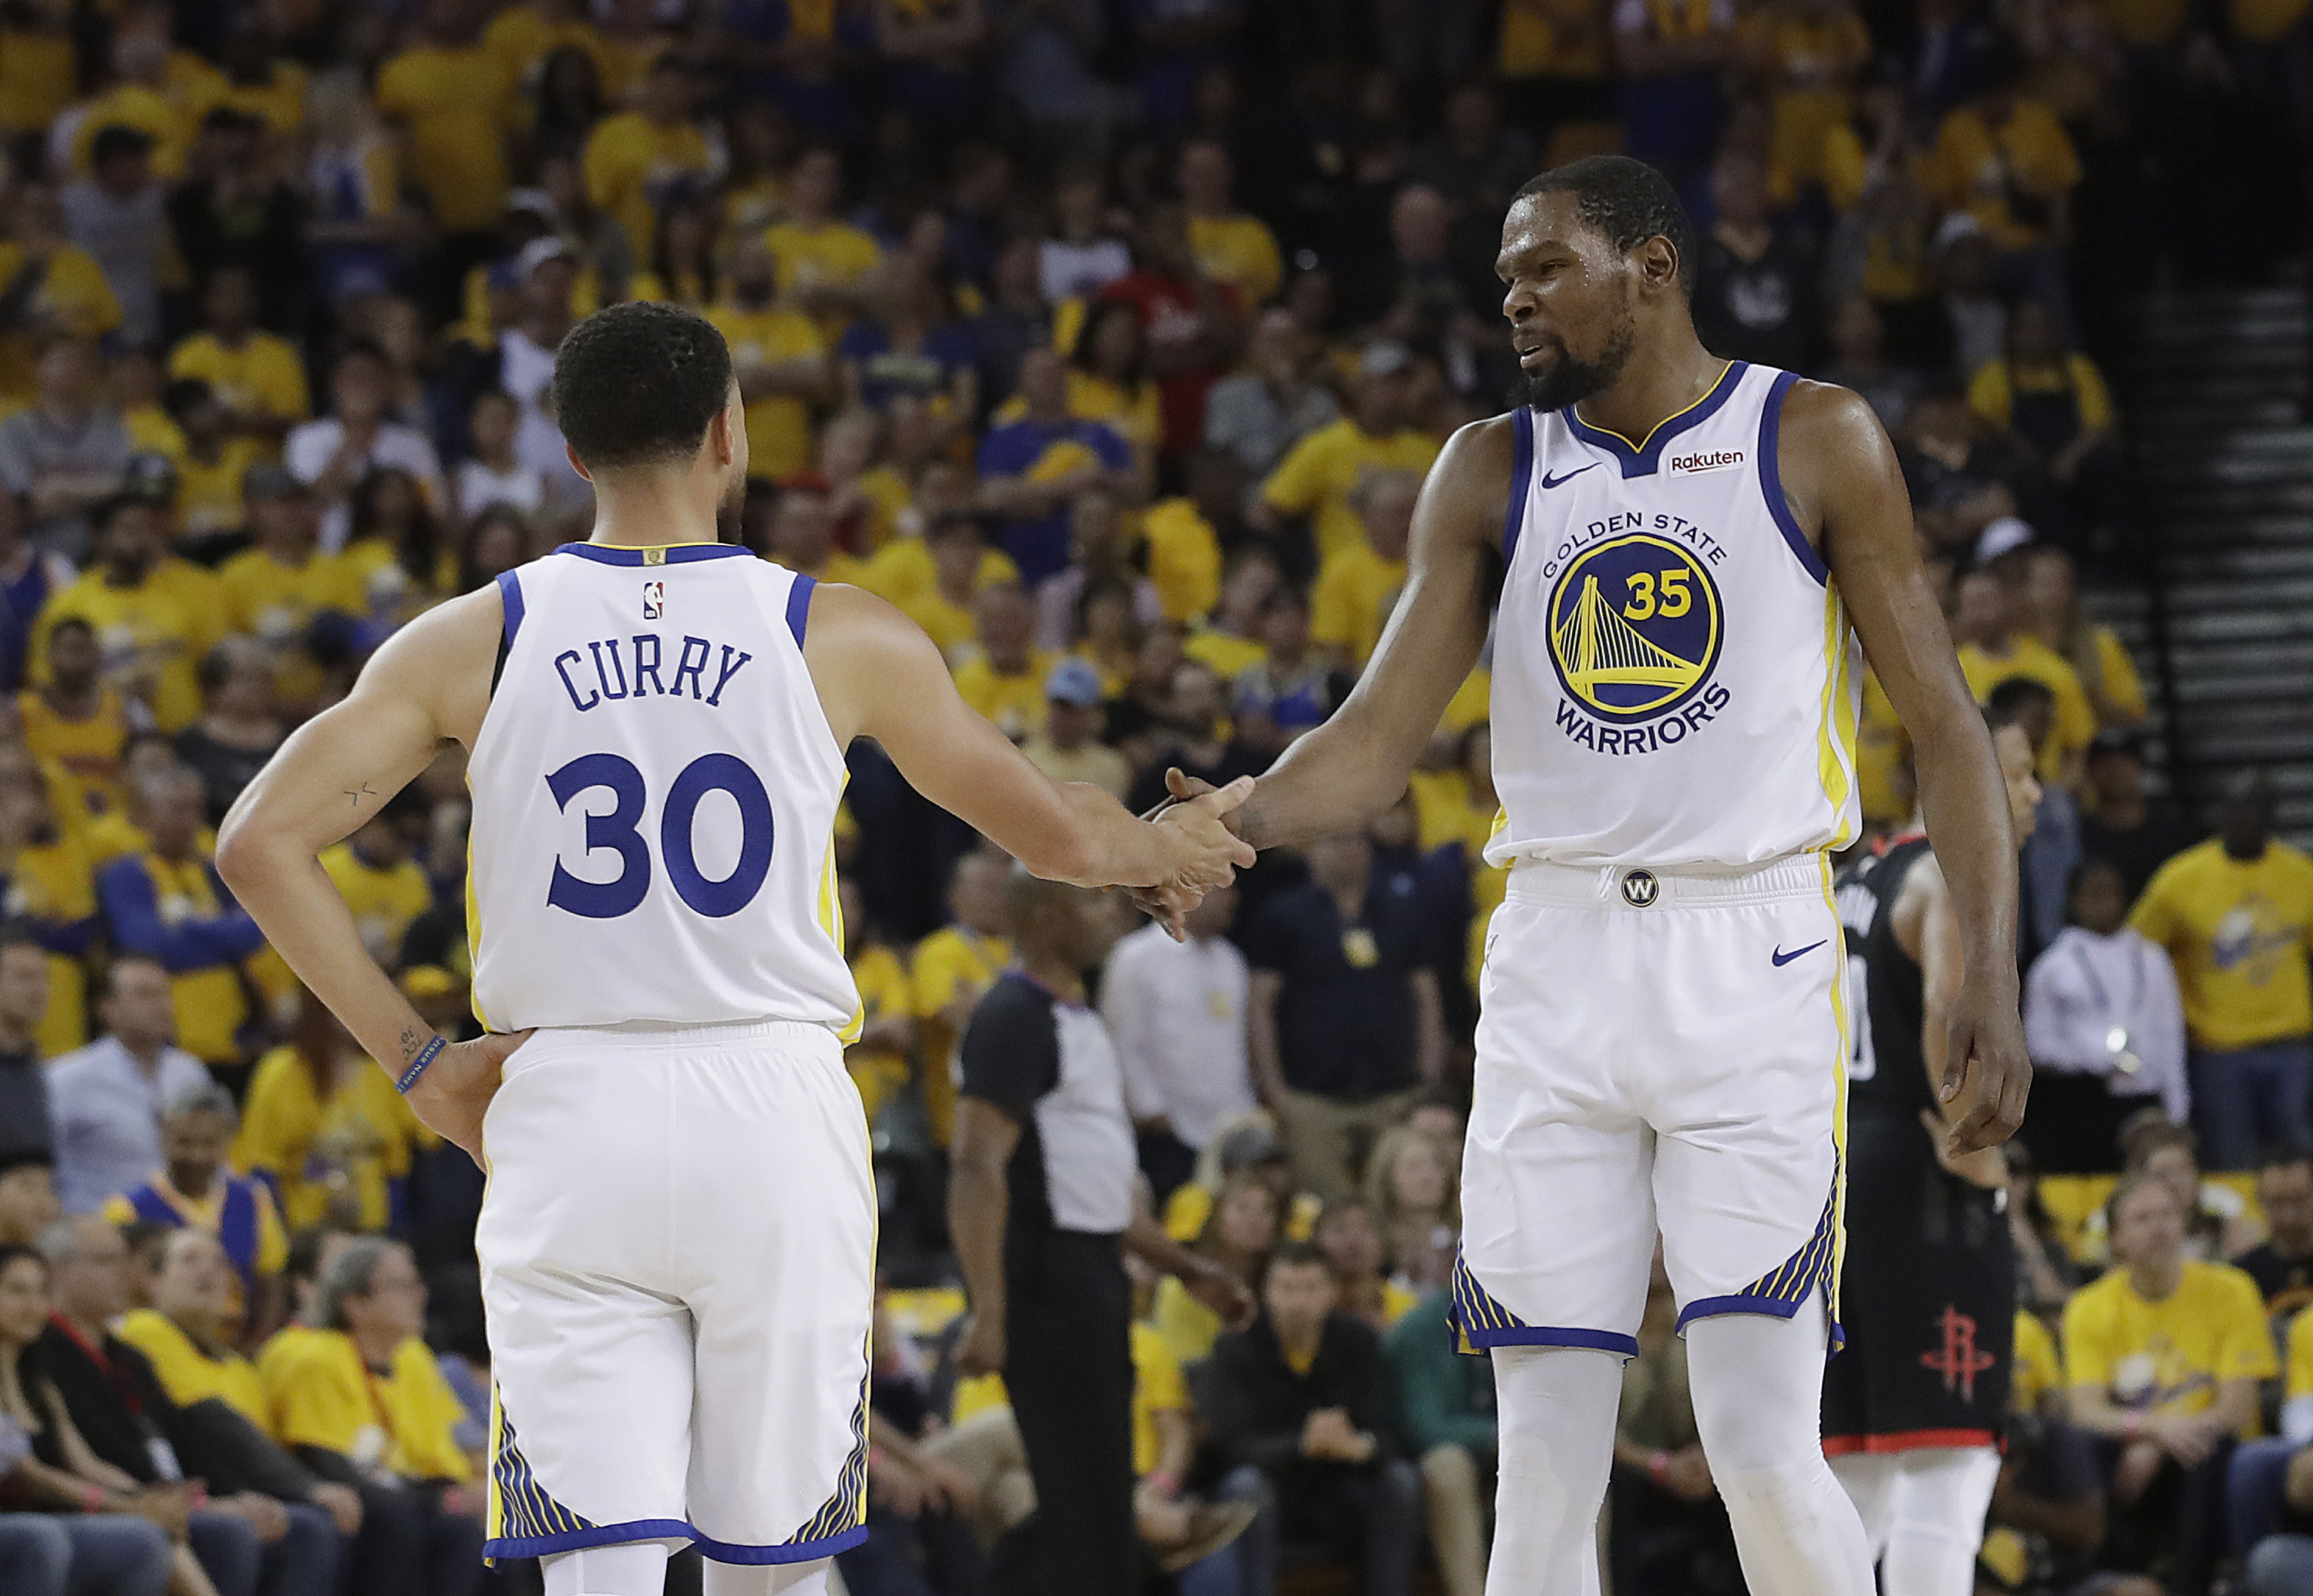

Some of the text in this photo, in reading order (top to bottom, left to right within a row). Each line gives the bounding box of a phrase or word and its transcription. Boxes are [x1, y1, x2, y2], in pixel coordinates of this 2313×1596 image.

[1672, 451, 1743, 471] Rakuten
[1543, 512, 1727, 579] GOLDEN STATE
[1623, 567, 1692, 620] 35
[554, 634, 752, 712] CURRY
[1554, 682, 1731, 756] WARRIORS
[544, 753, 774, 918] 30
[1625, 878, 1655, 901] W
